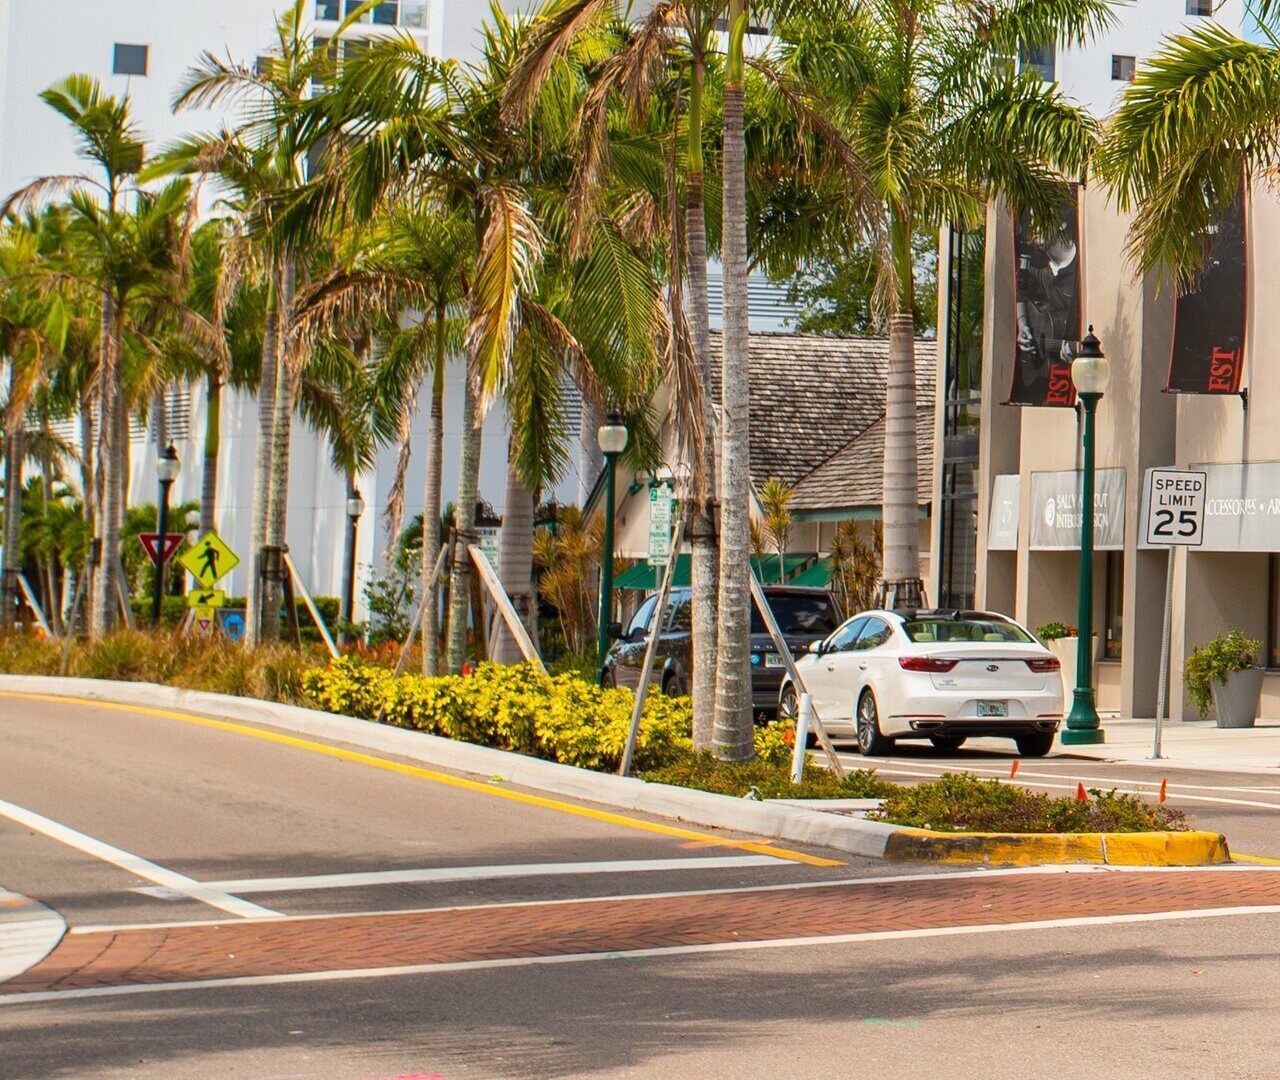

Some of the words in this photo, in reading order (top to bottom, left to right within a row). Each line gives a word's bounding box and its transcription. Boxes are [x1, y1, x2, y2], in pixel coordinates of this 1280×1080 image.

[1209, 347, 1235, 392] FST
[1046, 364, 1071, 404] FST
[1155, 479, 1202, 492] SPEED
[1056, 493, 1077, 510] SALLY
[1159, 494, 1196, 507] LIMIT
[1153, 509, 1198, 537] 25
